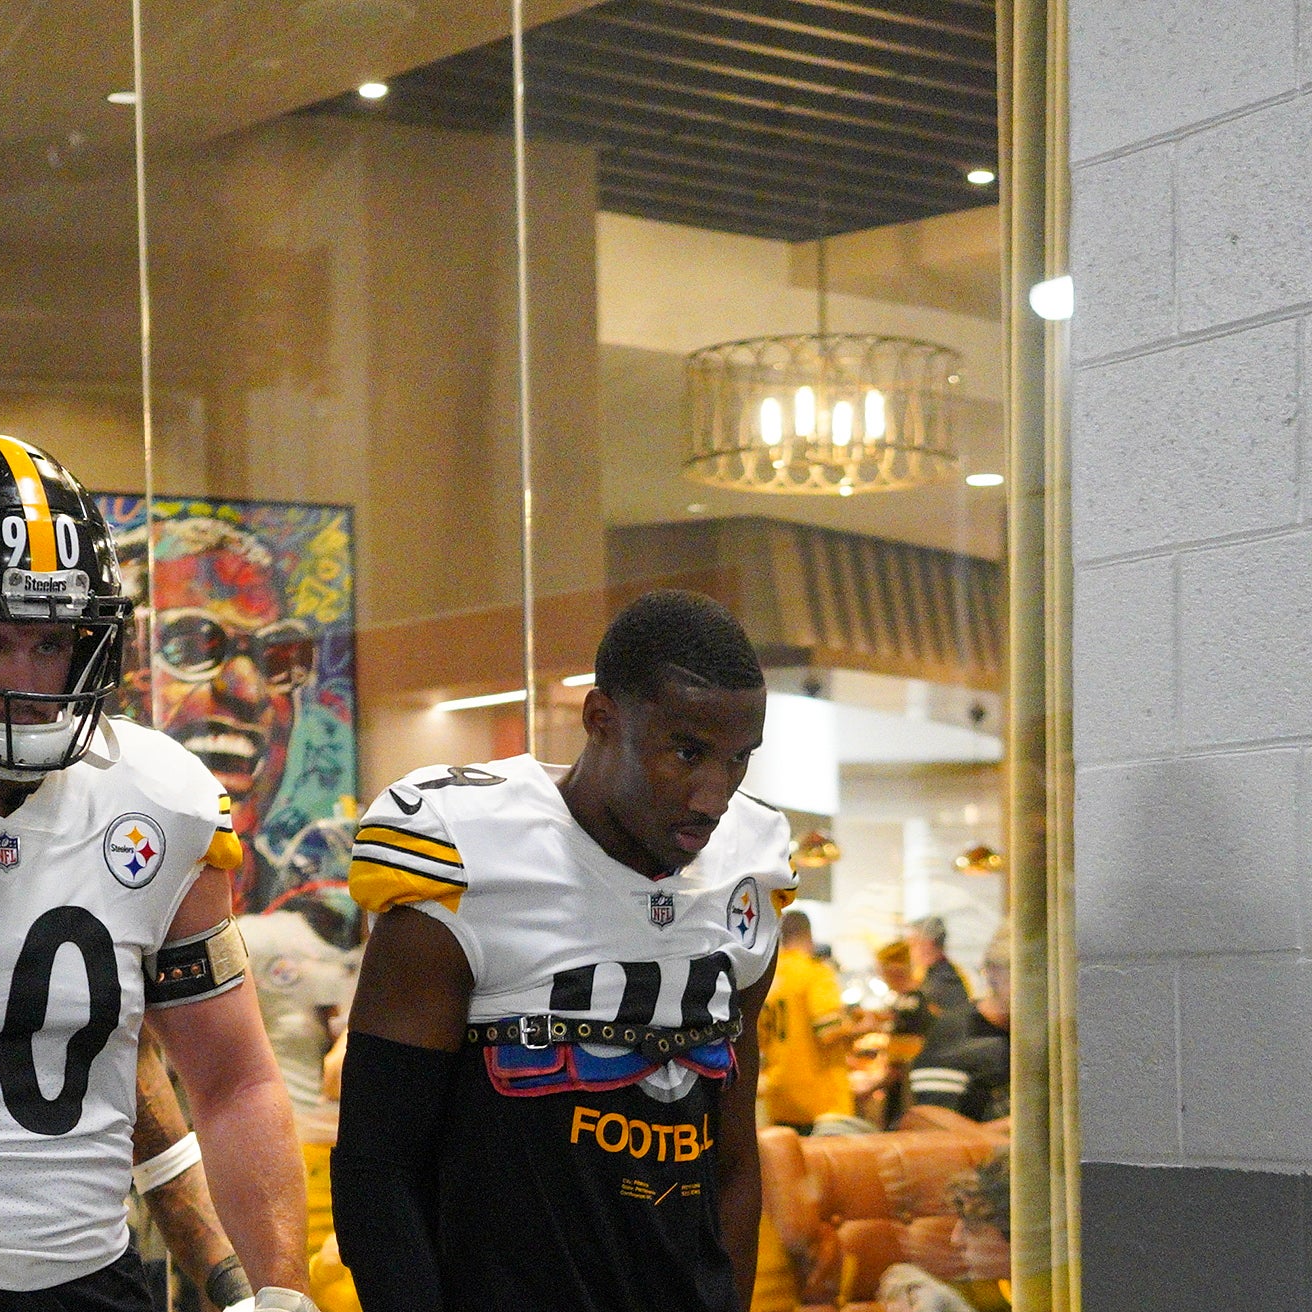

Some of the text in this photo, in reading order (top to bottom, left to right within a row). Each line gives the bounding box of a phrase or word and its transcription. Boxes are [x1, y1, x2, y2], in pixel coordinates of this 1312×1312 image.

[2, 513, 80, 568] 90
[24, 573, 67, 592] Steelers
[110, 843, 135, 854] Steelers
[652, 906, 673, 922] NFL
